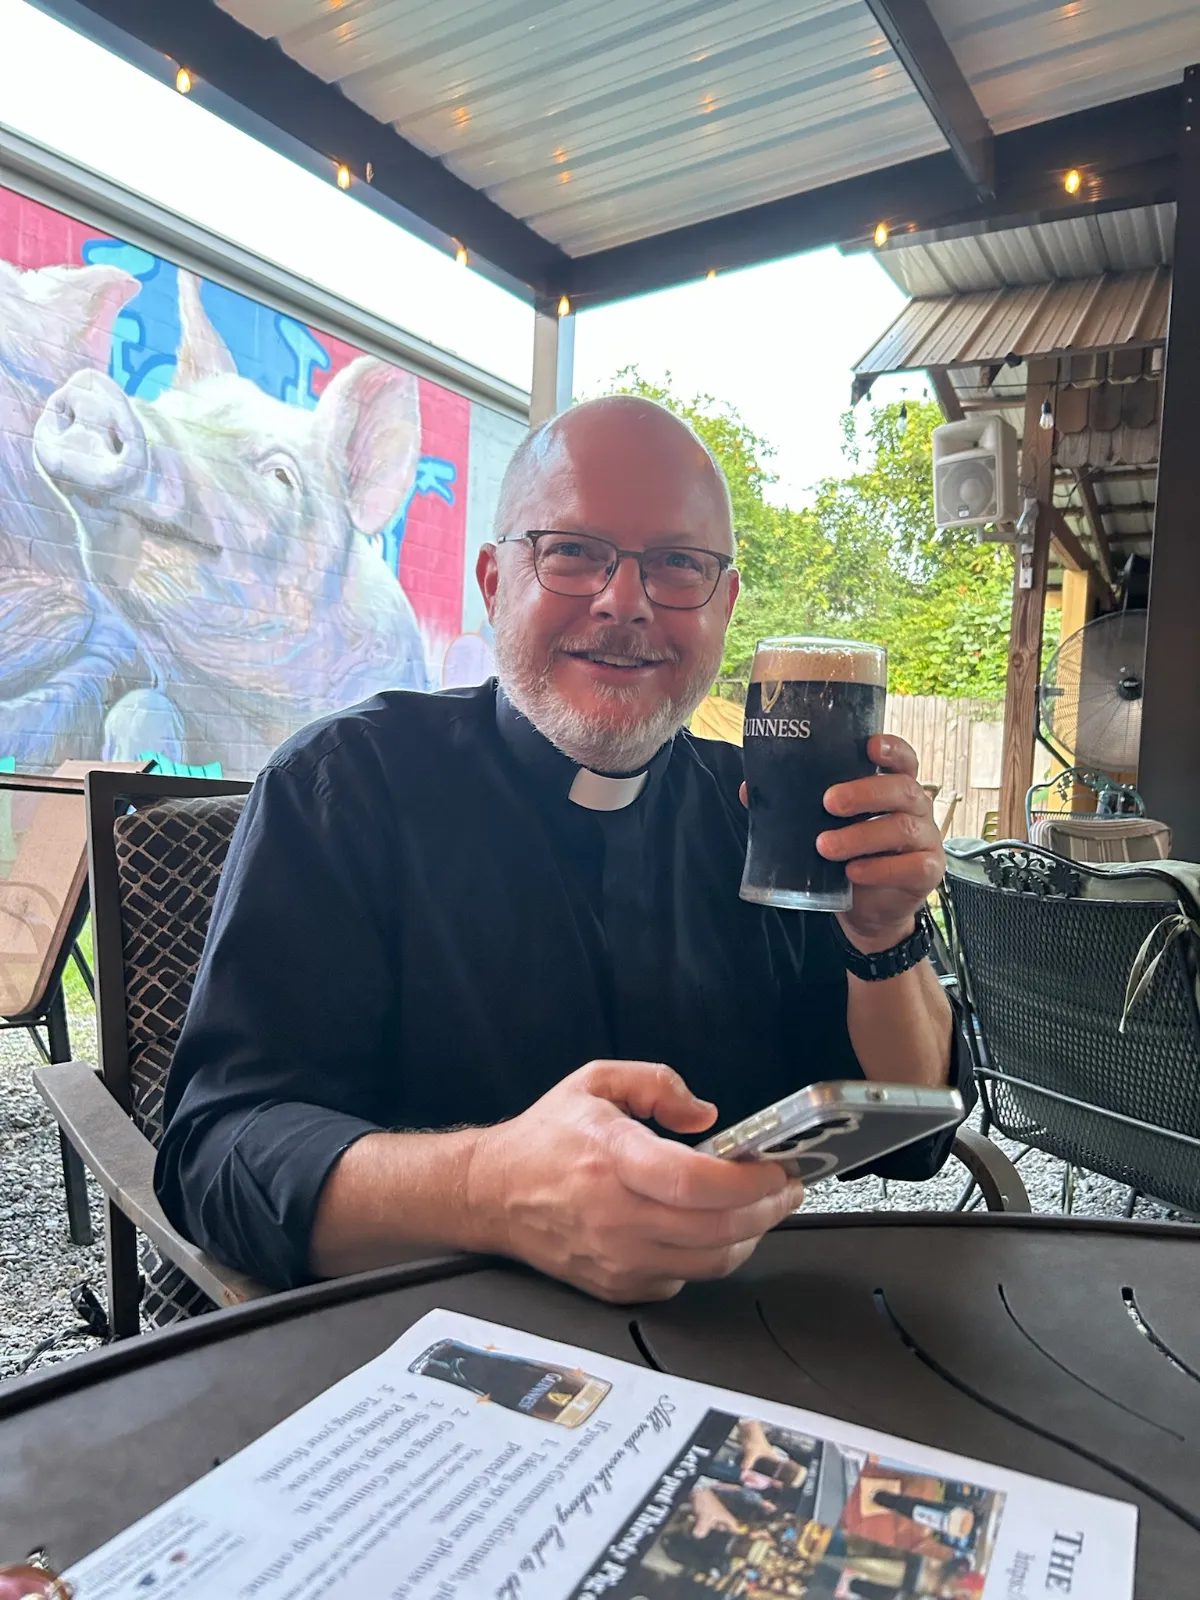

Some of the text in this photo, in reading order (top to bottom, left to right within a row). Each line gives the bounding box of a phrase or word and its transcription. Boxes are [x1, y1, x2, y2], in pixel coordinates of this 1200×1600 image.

[744, 716, 811, 739] UINNESS
[331, 1397, 382, 1427] Telling
[354, 1403, 406, 1437] Posting
[593, 1420, 612, 1432] If
[637, 1394, 676, 1433] All
[305, 1424, 341, 1449] your
[377, 1412, 430, 1448] Signing
[410, 1420, 455, 1449] Going
[576, 1427, 600, 1447] you
[623, 1423, 660, 1453] roads
[328, 1434, 364, 1459] your
[403, 1448, 421, 1460] to
[482, 1441, 523, 1478] poured
[563, 1447, 584, 1464] are
[382, 1459, 409, 1476] the
[588, 1449, 637, 1492] worth
[671, 1444, 712, 1481] Let's
[309, 1460, 370, 1501] logging
[488, 1481, 512, 1499] up
[512, 1468, 565, 1516] Guinness
[646, 1474, 688, 1506] put
[324, 1475, 389, 1524] Guinness
[479, 1497, 497, 1510] to
[555, 1482, 611, 1525] taking
[290, 1523, 334, 1553] Map
[523, 1525, 565, 1567] lead
[604, 1499, 671, 1566] Thirsty
[518, 1555, 545, 1572] to
[1045, 1529, 1084, 1594] THE
[580, 1558, 629, 1598] Pig
